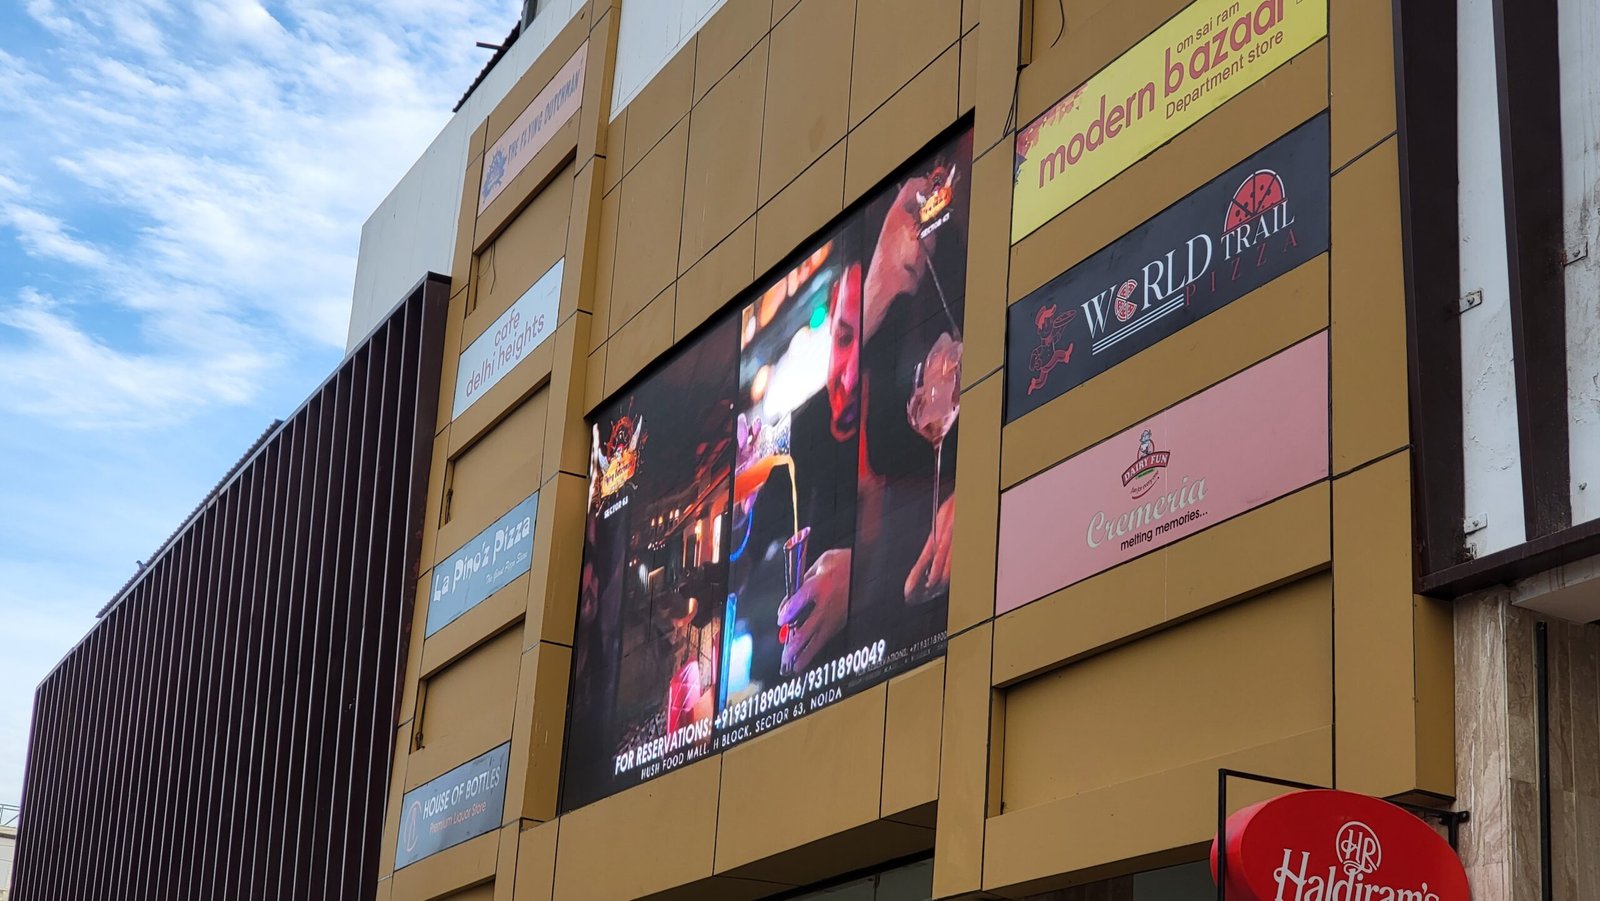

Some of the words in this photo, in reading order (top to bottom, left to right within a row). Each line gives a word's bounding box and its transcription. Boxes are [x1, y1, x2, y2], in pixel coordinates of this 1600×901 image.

[1176, 34, 1194, 54] om
[1196, 17, 1213, 41] sai
[1216, 1, 1240, 26] ram
[1166, 54, 1244, 120] Department
[1248, 30, 1283, 64] store
[1038, 81, 1156, 189] modern
[1221, 200, 1296, 261] TRAIL
[1184, 229, 1297, 306] PIZZA
[466, 353, 496, 397] delhi
[497, 313, 545, 370] heights
[494, 308, 520, 347] cafe
[1124, 459, 1148, 481] DAIRY
[1150, 454, 1168, 465] FUN
[604, 500, 622, 519] SECTOR
[1086, 475, 1209, 549] Cremeria
[1120, 528, 1153, 551] melting
[1155, 508, 1208, 537] memories...
[434, 574, 450, 602] La
[615, 750, 633, 776] FOR
[636, 717, 713, 767] RESERVATIONS:
[663, 754, 684, 772] FOOD
[713, 738, 720, 749] H
[755, 712, 789, 734] SECTOR
[810, 686, 842, 710] NOIDA
[423, 789, 450, 820] HOUSE
[451, 783, 465, 806] OF
[465, 767, 500, 799] BOTTLES
[429, 815, 453, 833] Premium
[453, 807, 472, 826] Liquor
[472, 801, 487, 817] Store
